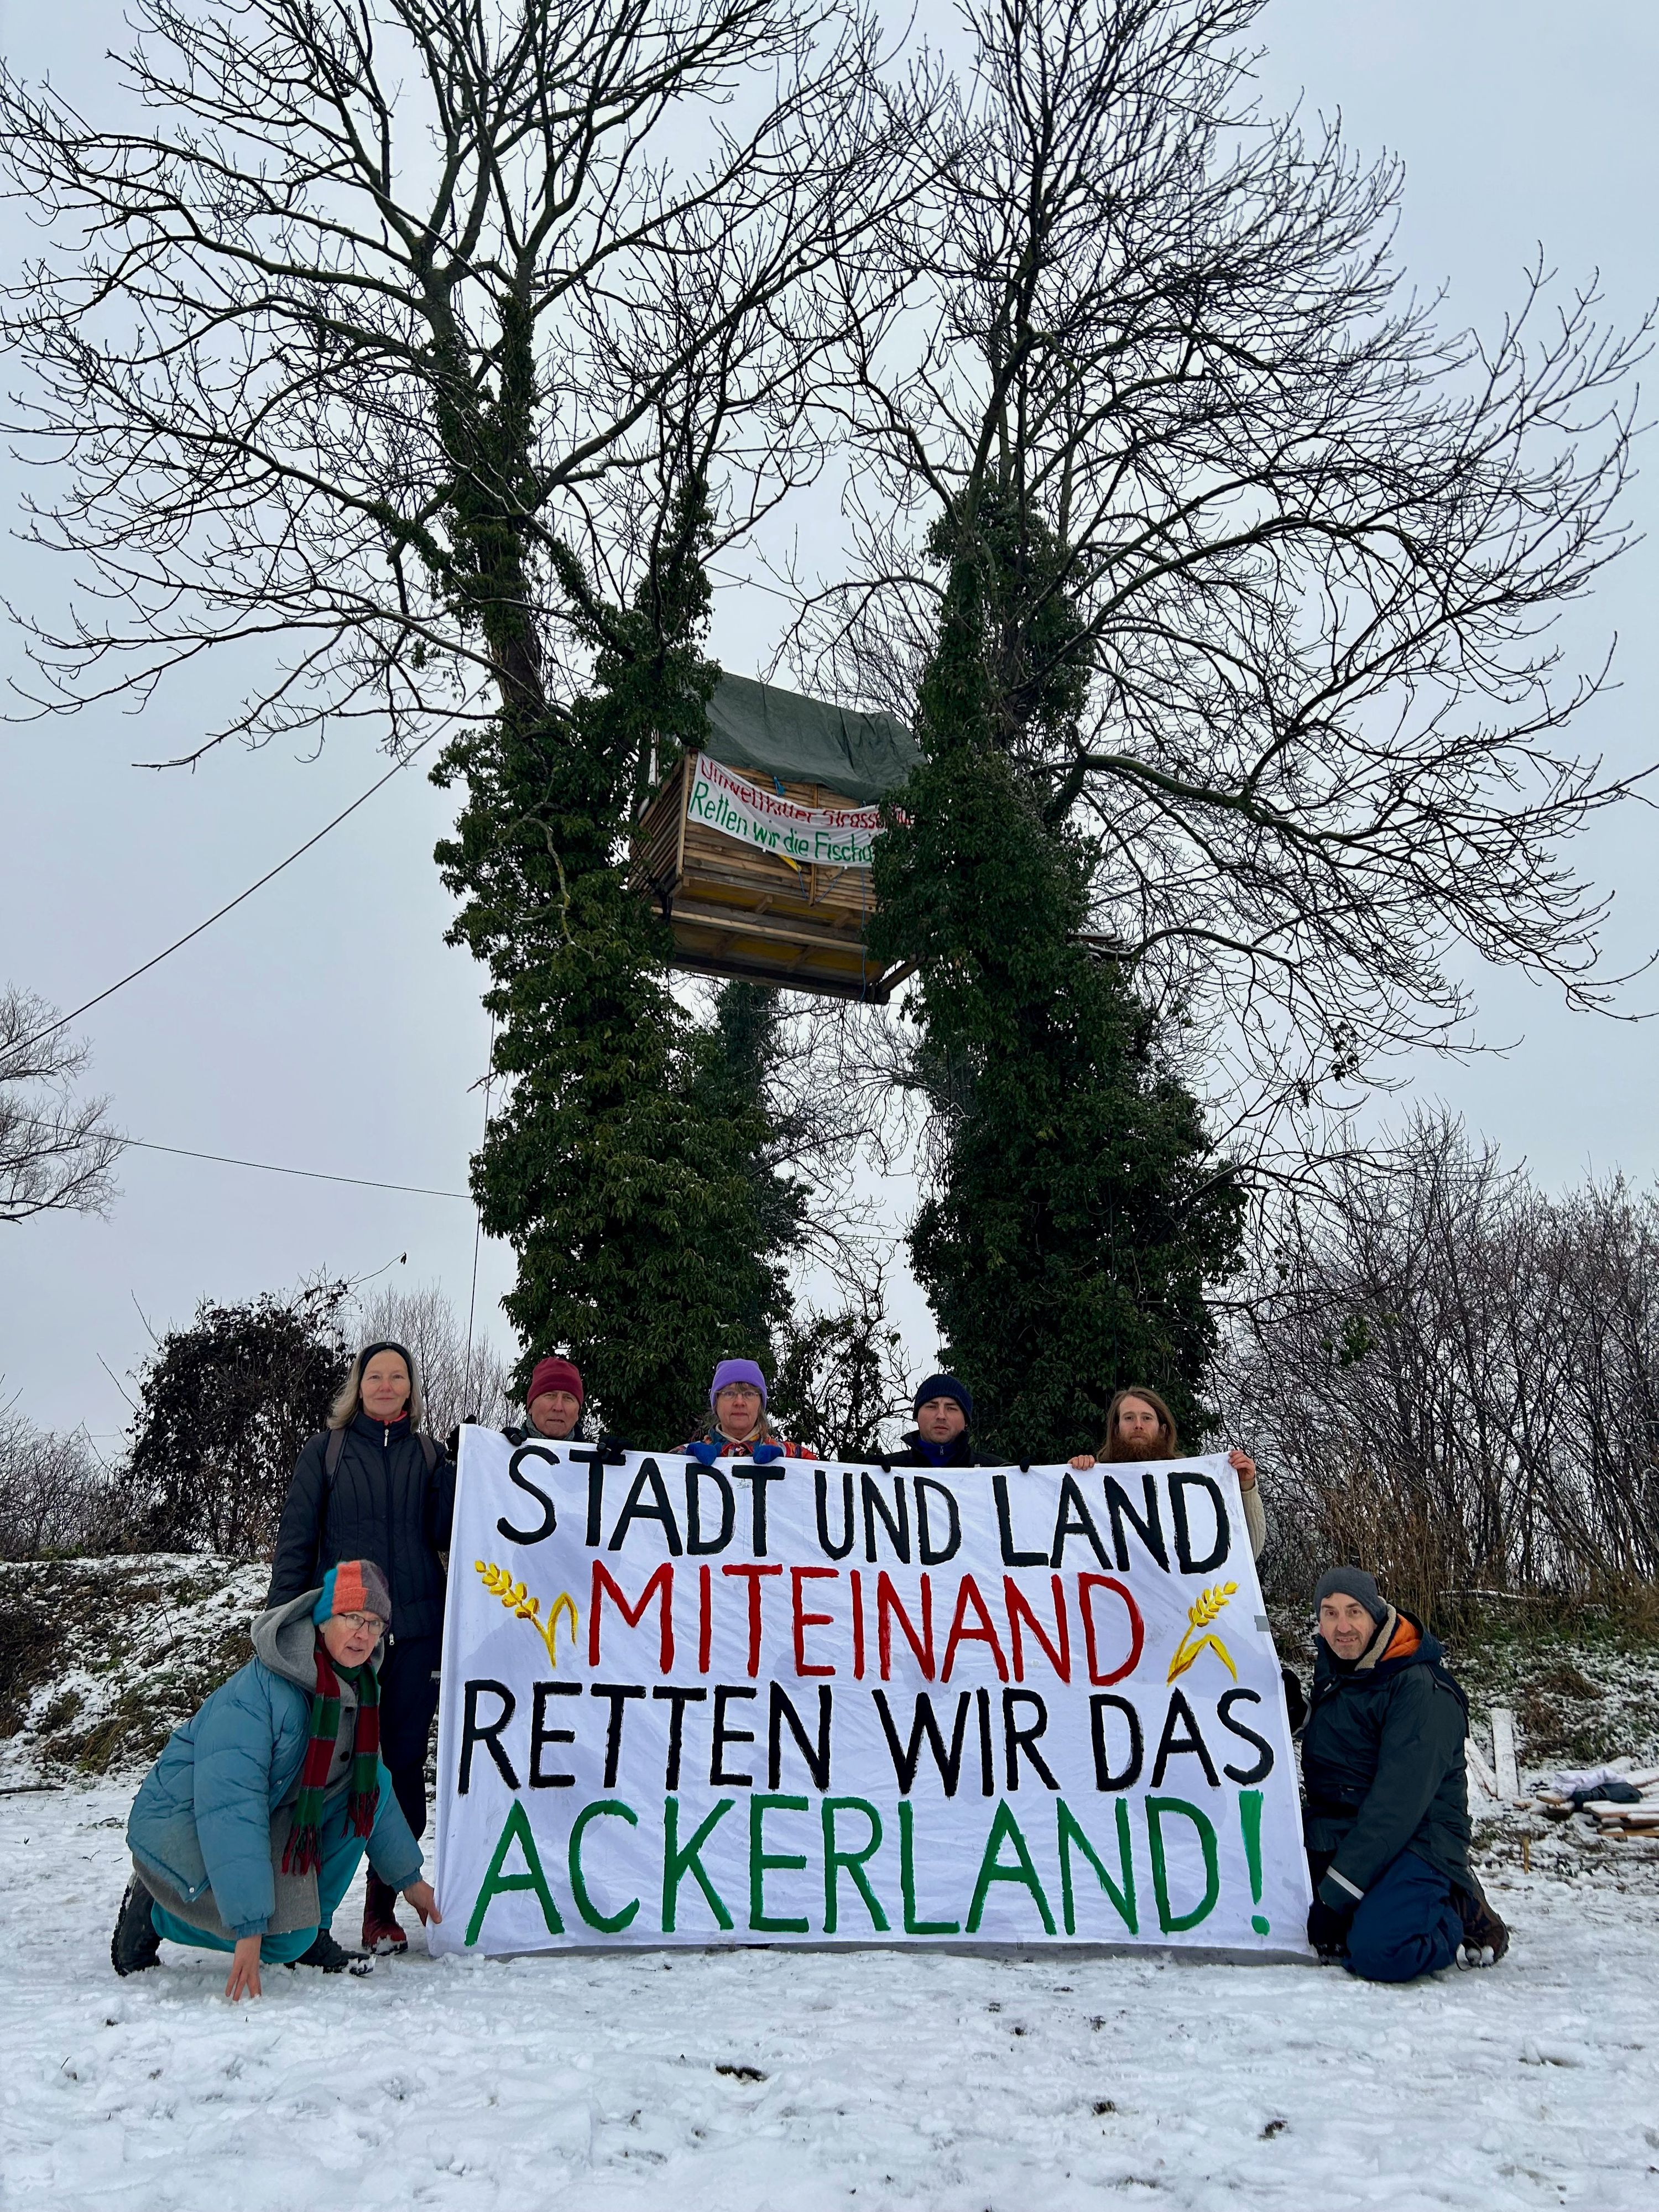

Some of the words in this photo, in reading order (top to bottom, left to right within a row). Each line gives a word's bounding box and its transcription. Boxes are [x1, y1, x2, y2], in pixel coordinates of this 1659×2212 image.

[690, 781, 748, 837] Retten
[753, 821, 780, 848] wir
[784, 827, 808, 857] die
[497, 1444, 786, 1557] STADT
[814, 1469, 962, 1566] UND
[992, 1472, 1231, 1575] LAND
[588, 1559, 1145, 1687] MITEINAND
[457, 1679, 832, 1797] RETTEN
[871, 1687, 1061, 1798] WIR
[1088, 1687, 1274, 1792] DAS
[465, 1791, 1270, 1947] ACKERLAND!
